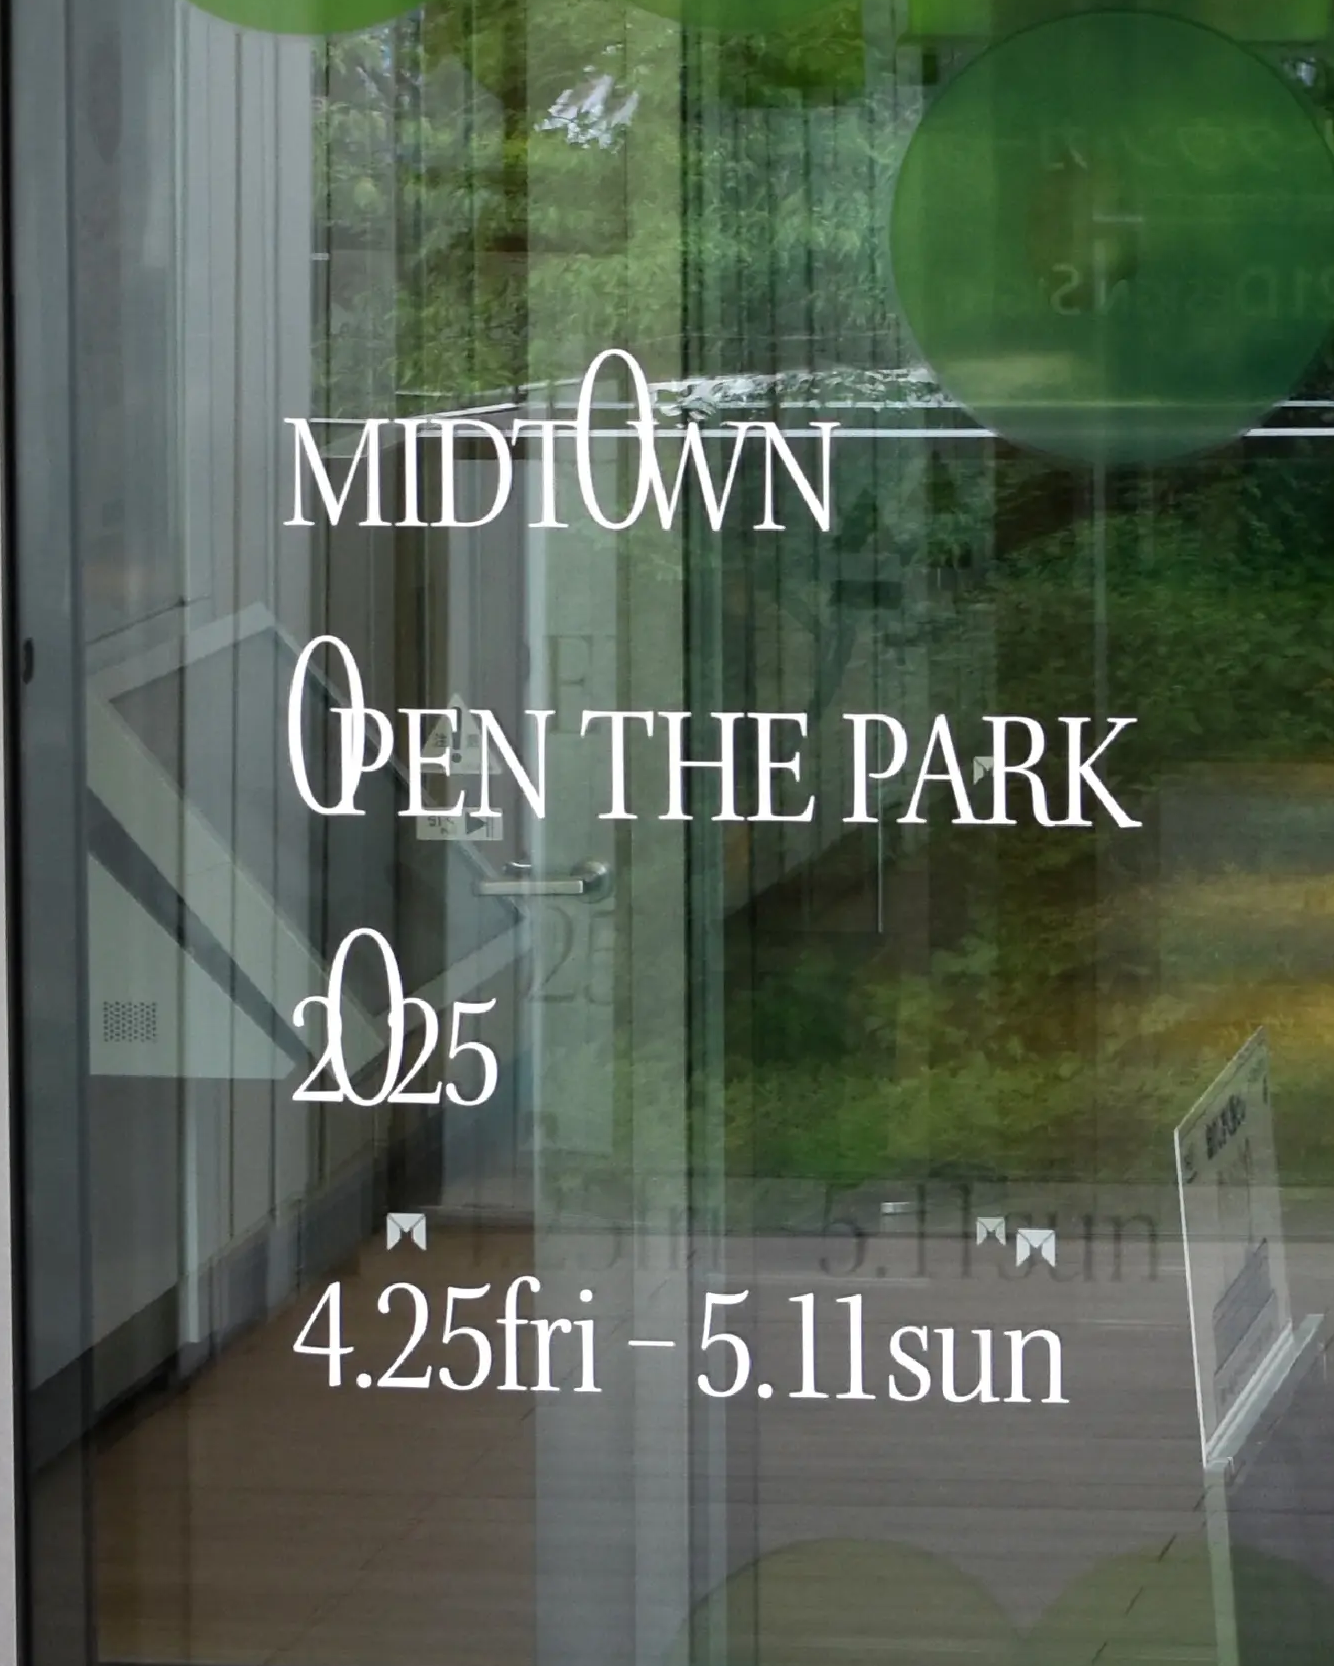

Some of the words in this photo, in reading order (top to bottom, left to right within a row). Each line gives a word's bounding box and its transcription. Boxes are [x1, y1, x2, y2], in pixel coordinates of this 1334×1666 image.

[283, 348, 840, 532] MIDTOWN
[288, 635, 555, 819] OPEN
[580, 710, 815, 822] THE
[842, 713, 1142, 828] PARK
[292, 928, 498, 1107] 2025
[293, 1275, 602, 1392] 4.25fri
[697, 1289, 1070, 1404] 5.11sun
